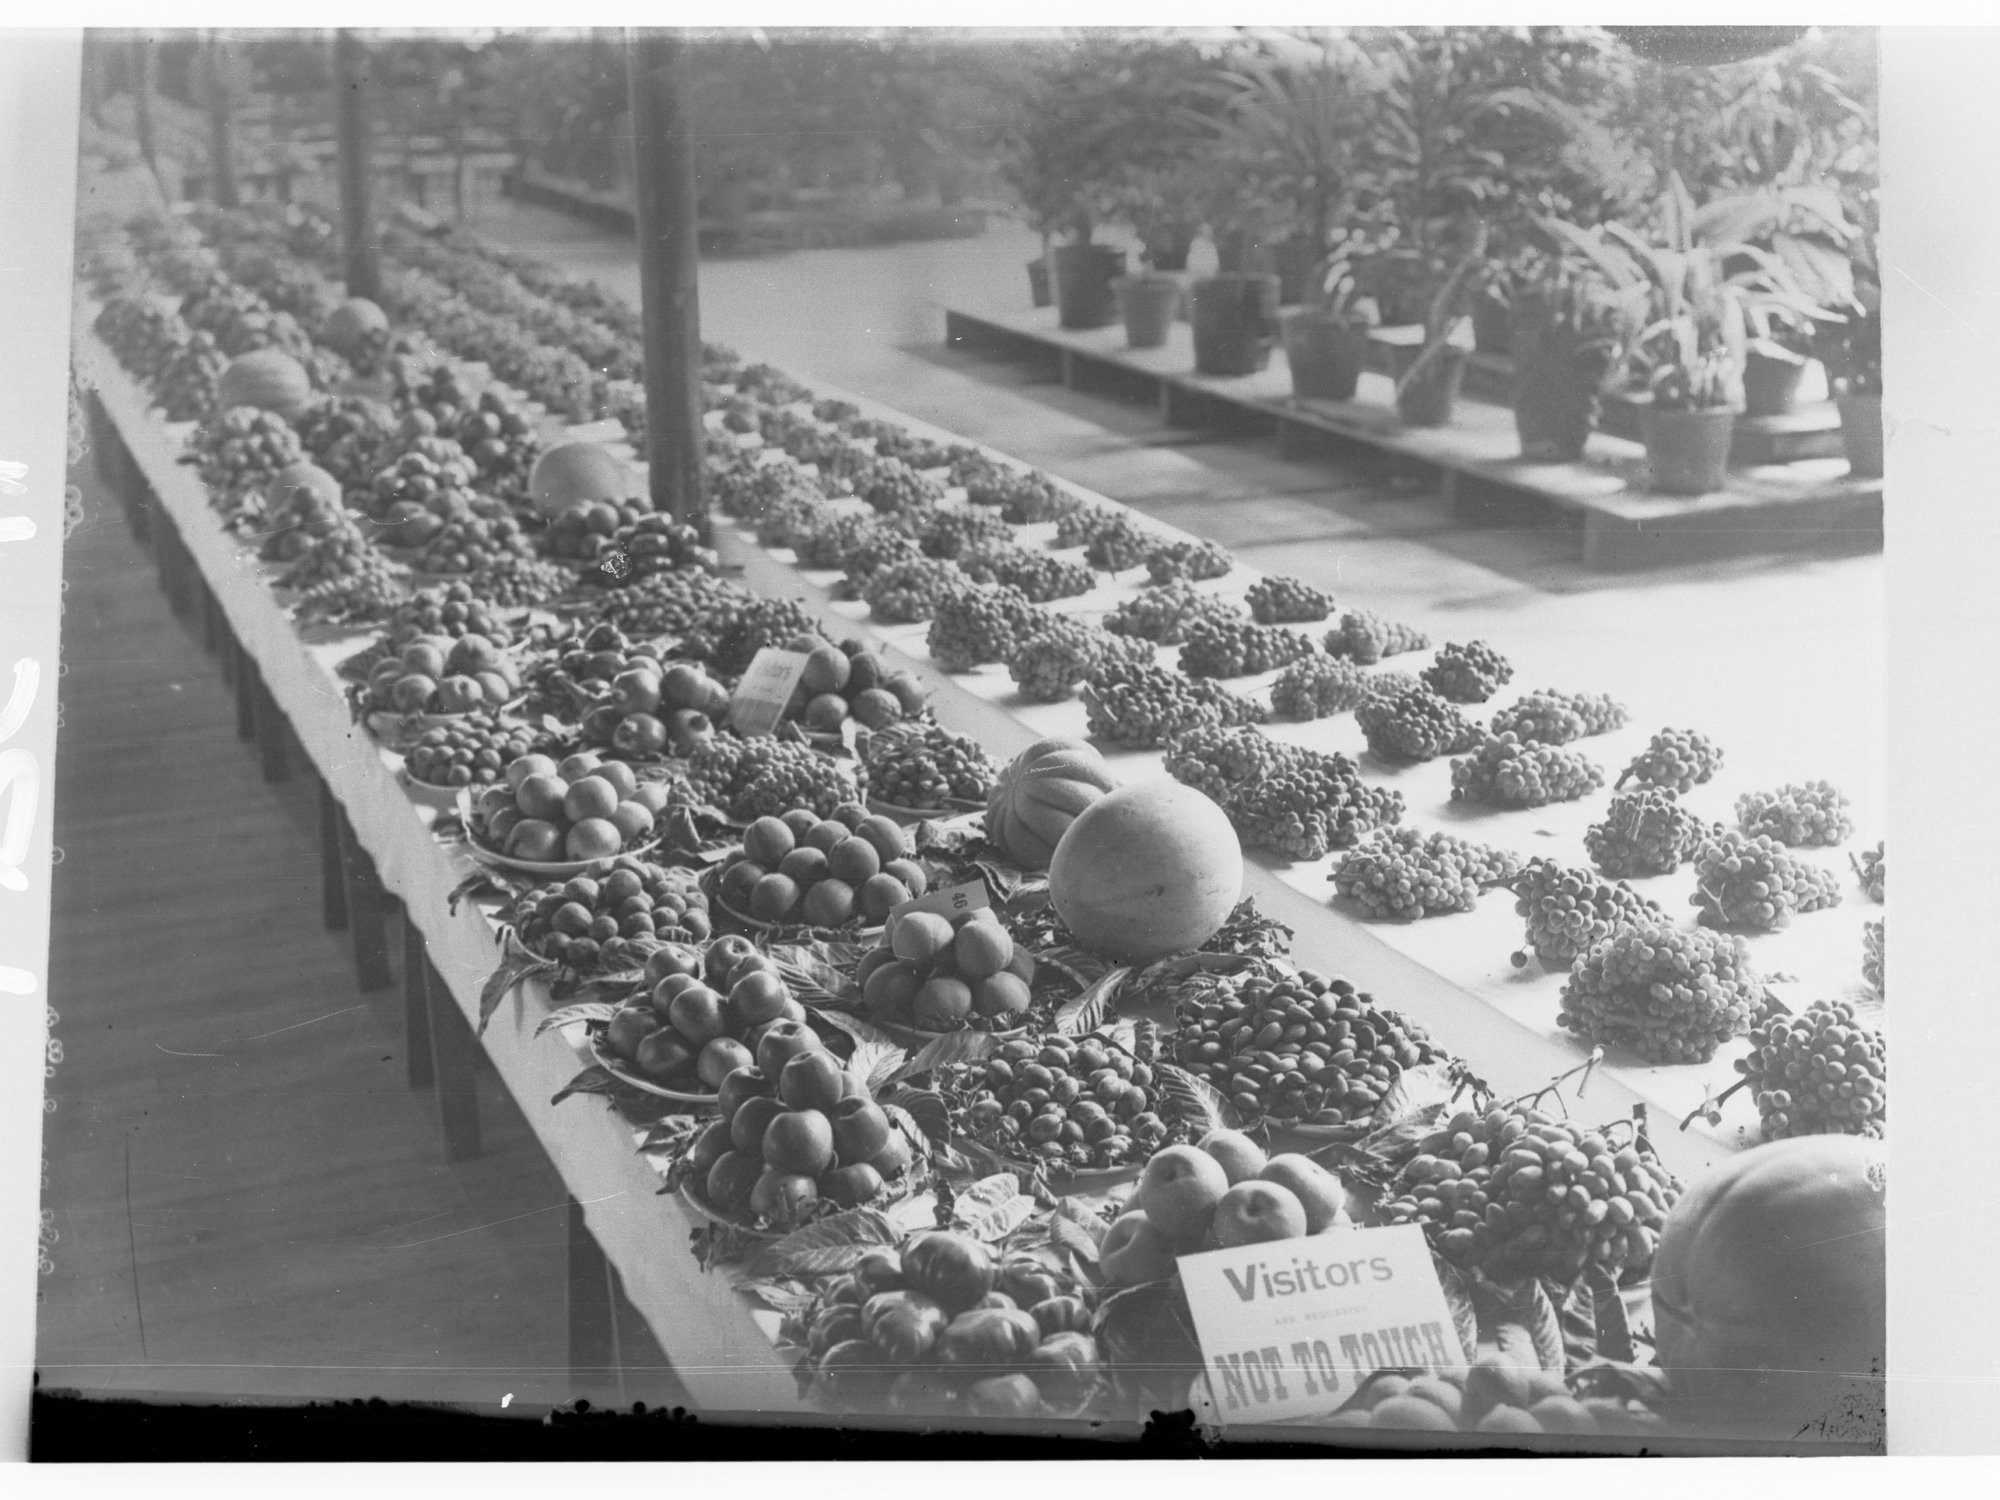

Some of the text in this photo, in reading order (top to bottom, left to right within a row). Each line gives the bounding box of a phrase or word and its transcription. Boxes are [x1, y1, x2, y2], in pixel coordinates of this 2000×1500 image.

[952, 892, 968, 909] 46
[1223, 1256, 1393, 1302] Visitors
[1213, 1321, 1451, 1411] NOT TO TOUCH
